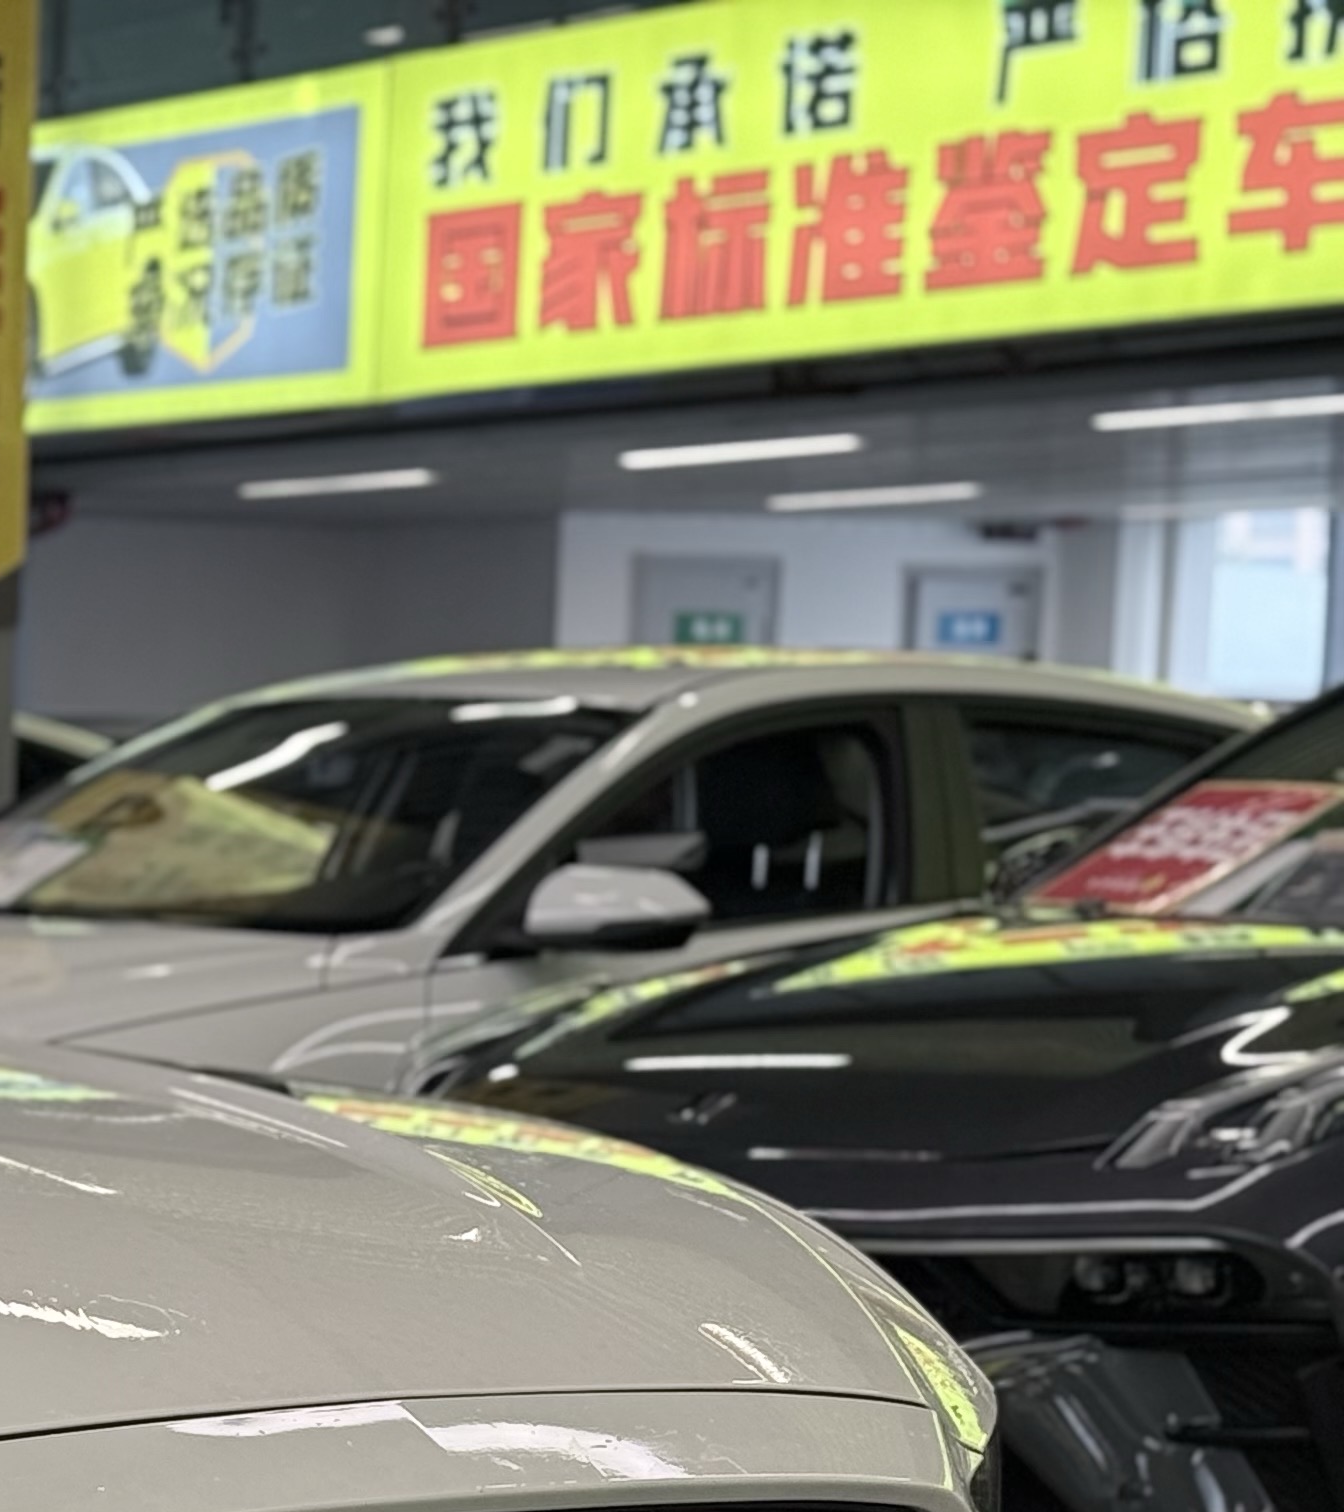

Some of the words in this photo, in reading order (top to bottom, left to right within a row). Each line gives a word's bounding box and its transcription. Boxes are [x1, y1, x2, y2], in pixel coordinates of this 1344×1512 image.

[431, 32, 857, 188] 我们承诺
[422, 92, 1344, 349] 国家标准鉴定车
